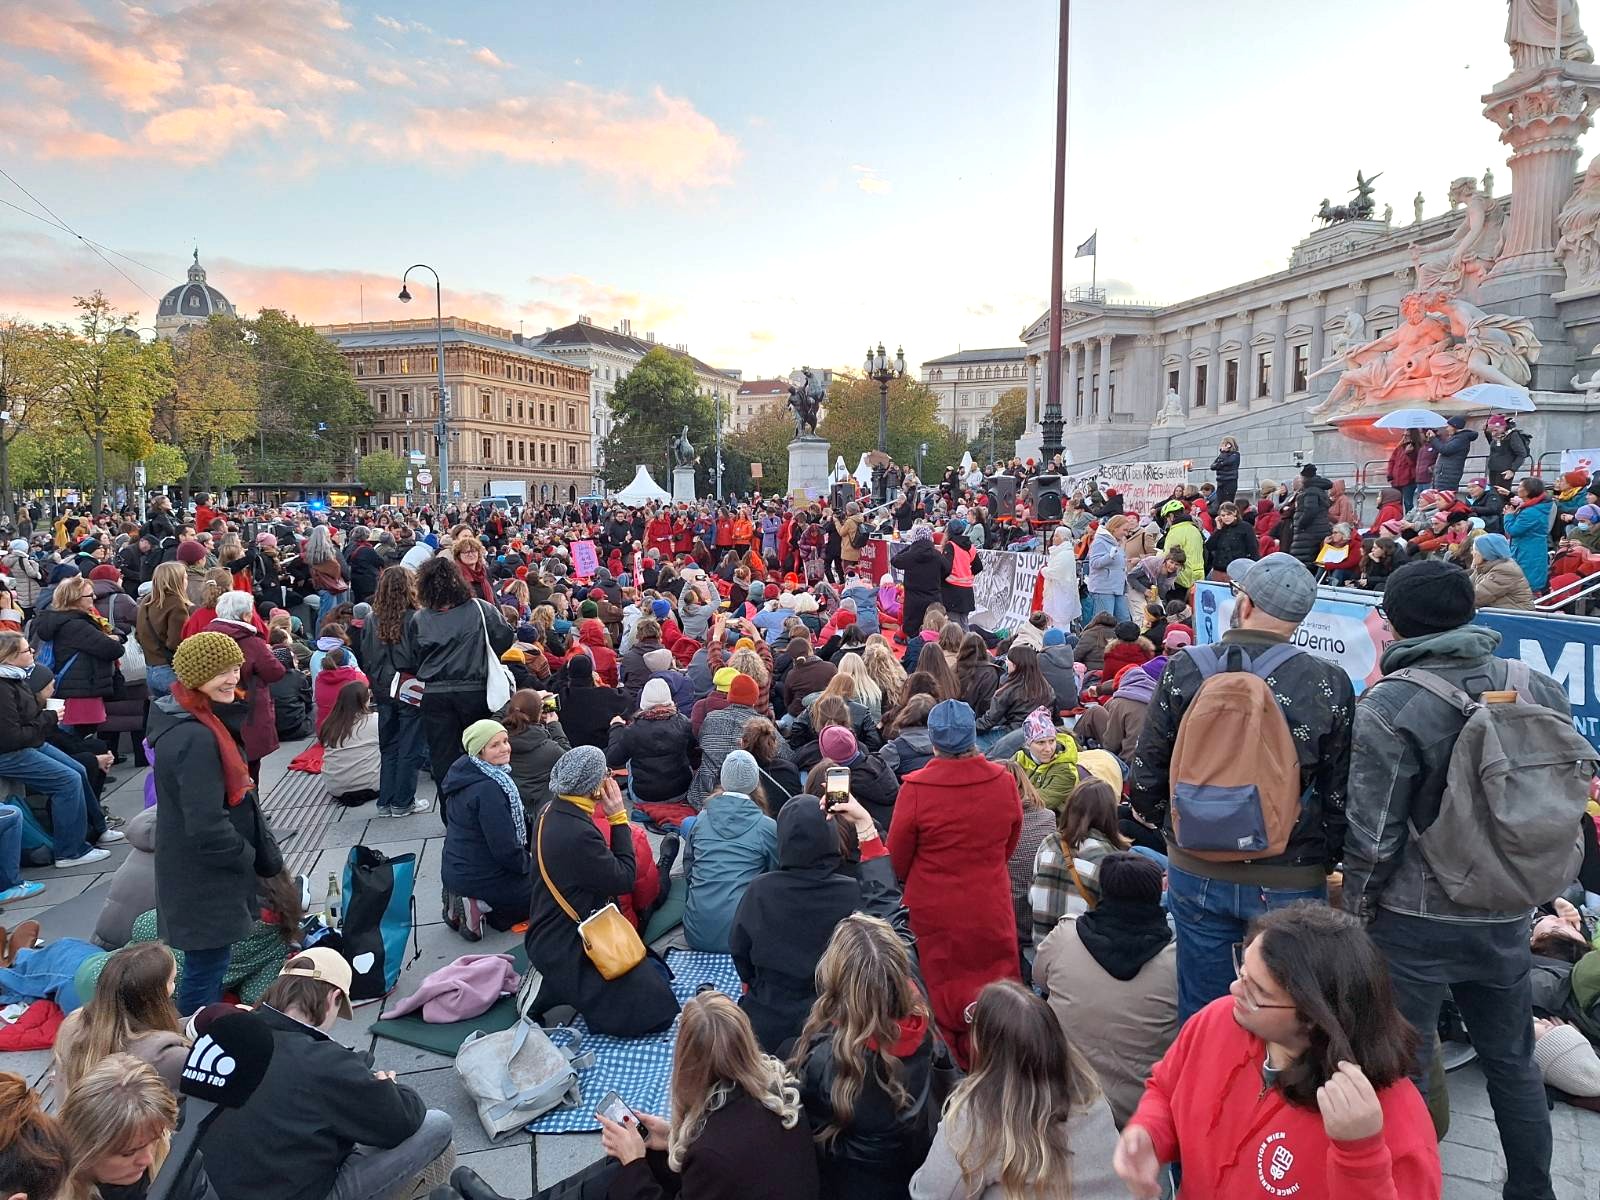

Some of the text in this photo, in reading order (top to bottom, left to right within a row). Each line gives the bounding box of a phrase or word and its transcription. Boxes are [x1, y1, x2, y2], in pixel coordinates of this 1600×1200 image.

[207, 1074, 226, 1087] FRO
[1257, 1131, 1300, 1196] JUNGE GENERATION WIEN
